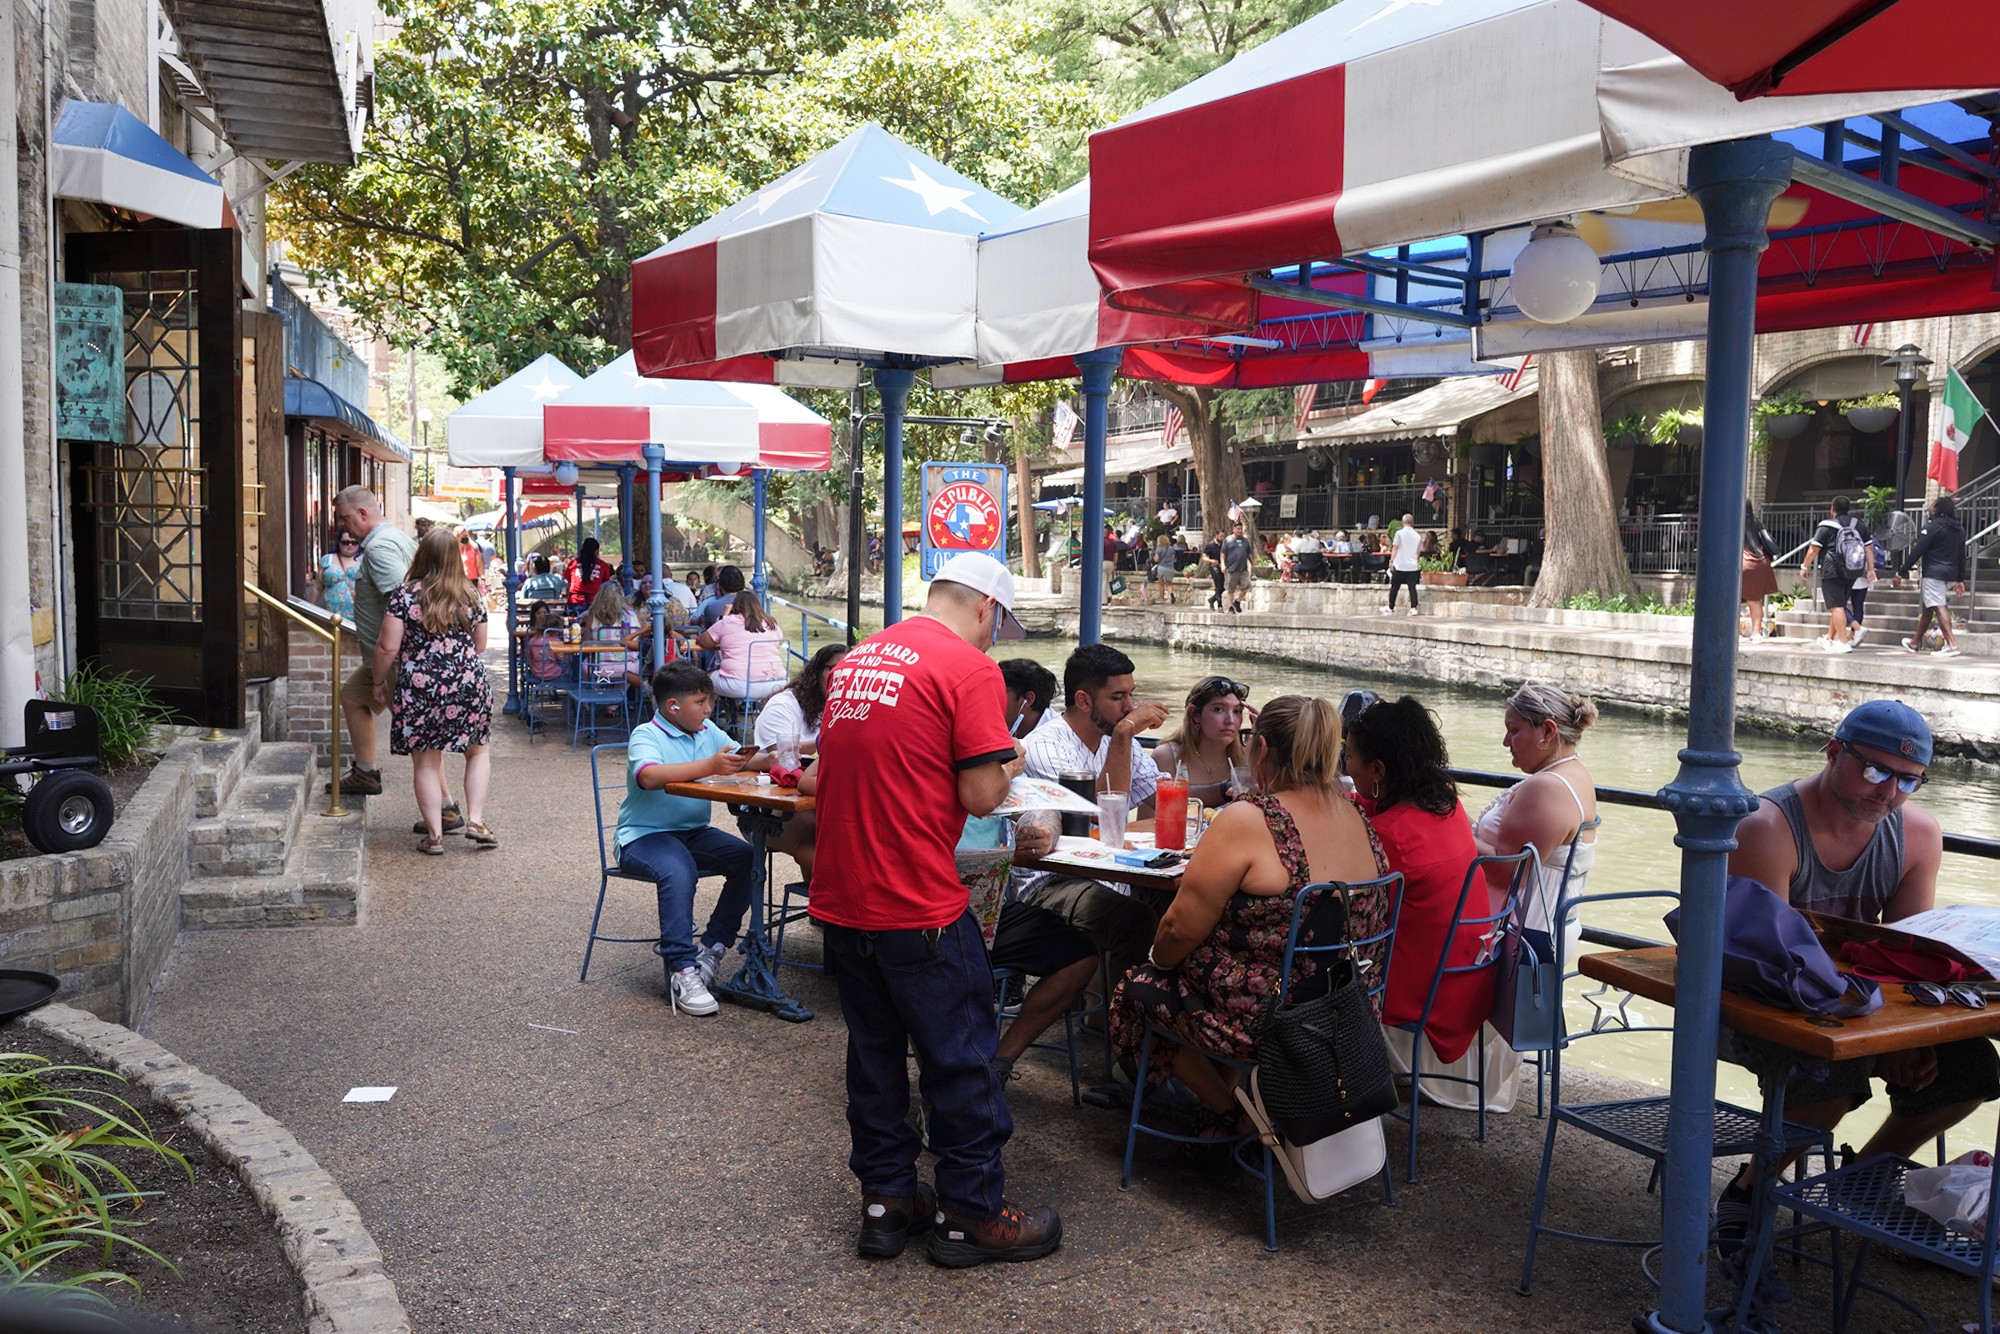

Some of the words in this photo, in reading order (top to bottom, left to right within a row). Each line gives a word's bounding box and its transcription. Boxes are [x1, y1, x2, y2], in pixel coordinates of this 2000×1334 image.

[952, 470, 979, 480] THE
[933, 487, 997, 518] REPUBLIC
[934, 551, 951, 571] OF
[857, 655, 882, 667] AND
[880, 643, 919, 665] HARD
[845, 669, 905, 707] NICE
[828, 700, 871, 728] Y'all
